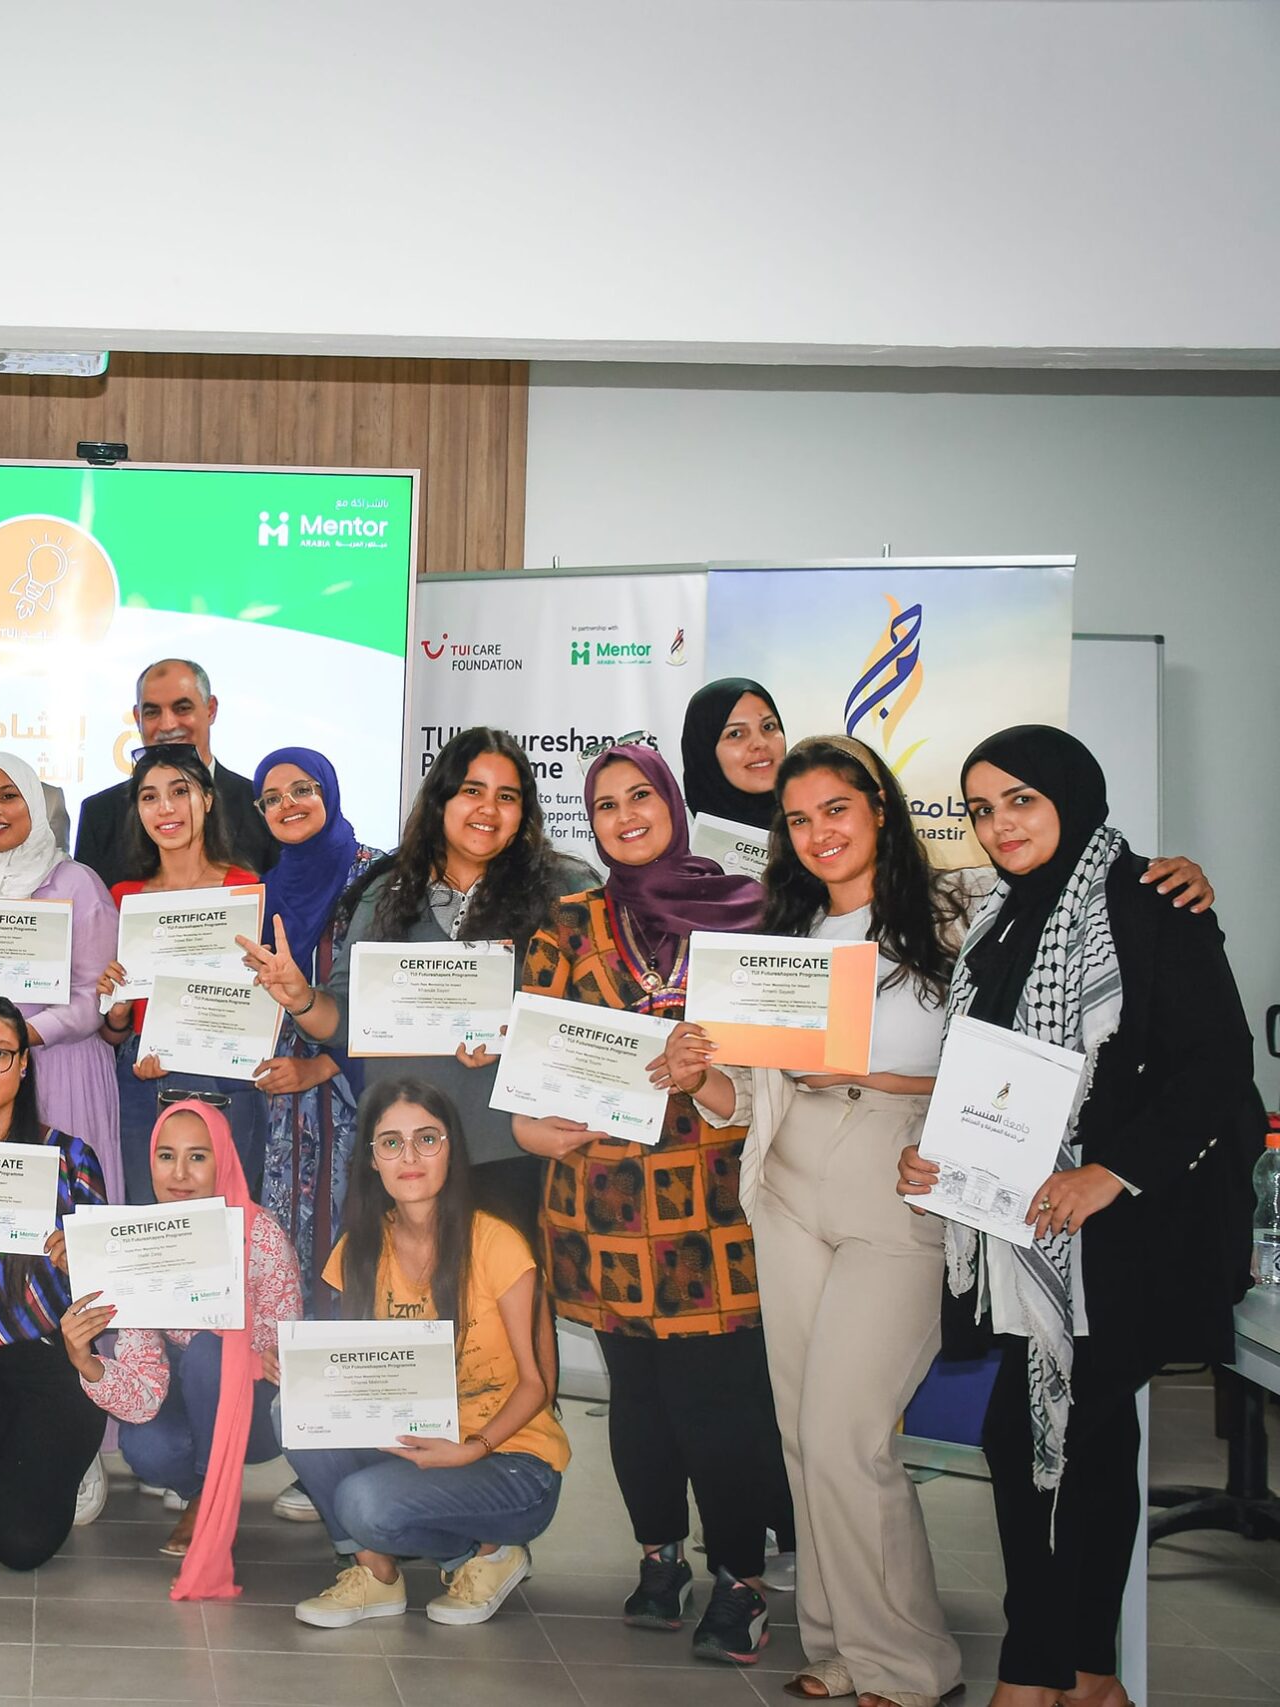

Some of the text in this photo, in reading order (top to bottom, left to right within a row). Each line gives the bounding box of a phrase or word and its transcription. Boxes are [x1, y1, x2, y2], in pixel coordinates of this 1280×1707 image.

[300, 514, 389, 537] Mentor
[451, 644, 501, 656] TUI CARE
[597, 643, 651, 656] Mentor
[452, 659, 522, 671] FOUNDATION
[538, 793, 582, 804] to turn
[543, 811, 589, 823] pportu
[550, 826, 595, 842] for Imp
[917, 827, 967, 841] nastir
[159, 911, 227, 924] CERTIFICATE
[400, 959, 477, 970] CERTIFICATE
[740, 956, 829, 969] CERTIFICATE
[188, 984, 251, 999] CERTIFICATE
[559, 1023, 639, 1049] CERTIFICATE
[961, 1104, 1003, 1124] المنستير
[111, 1219, 190, 1237] CERTIFICATE
[330, 1351, 414, 1363] CERTIFICATE
